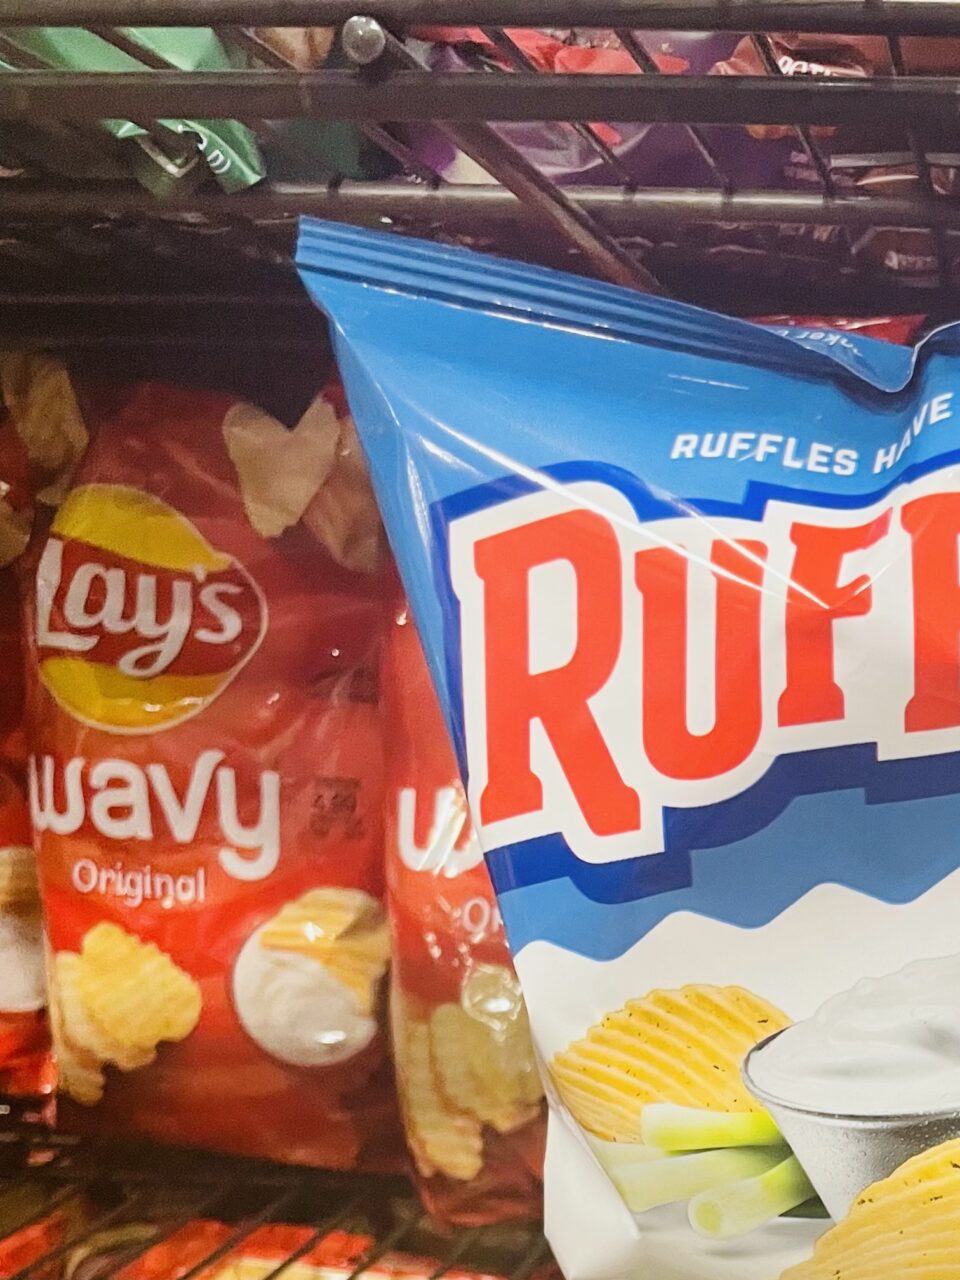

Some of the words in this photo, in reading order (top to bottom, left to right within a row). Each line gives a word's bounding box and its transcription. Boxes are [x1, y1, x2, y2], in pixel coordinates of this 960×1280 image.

[671, 431, 858, 477] RUFFLES
[873, 391, 954, 476] HAVE
[36, 538, 243, 677] Lay's
[29, 749, 280, 880] wavy
[72, 859, 206, 909] Original
